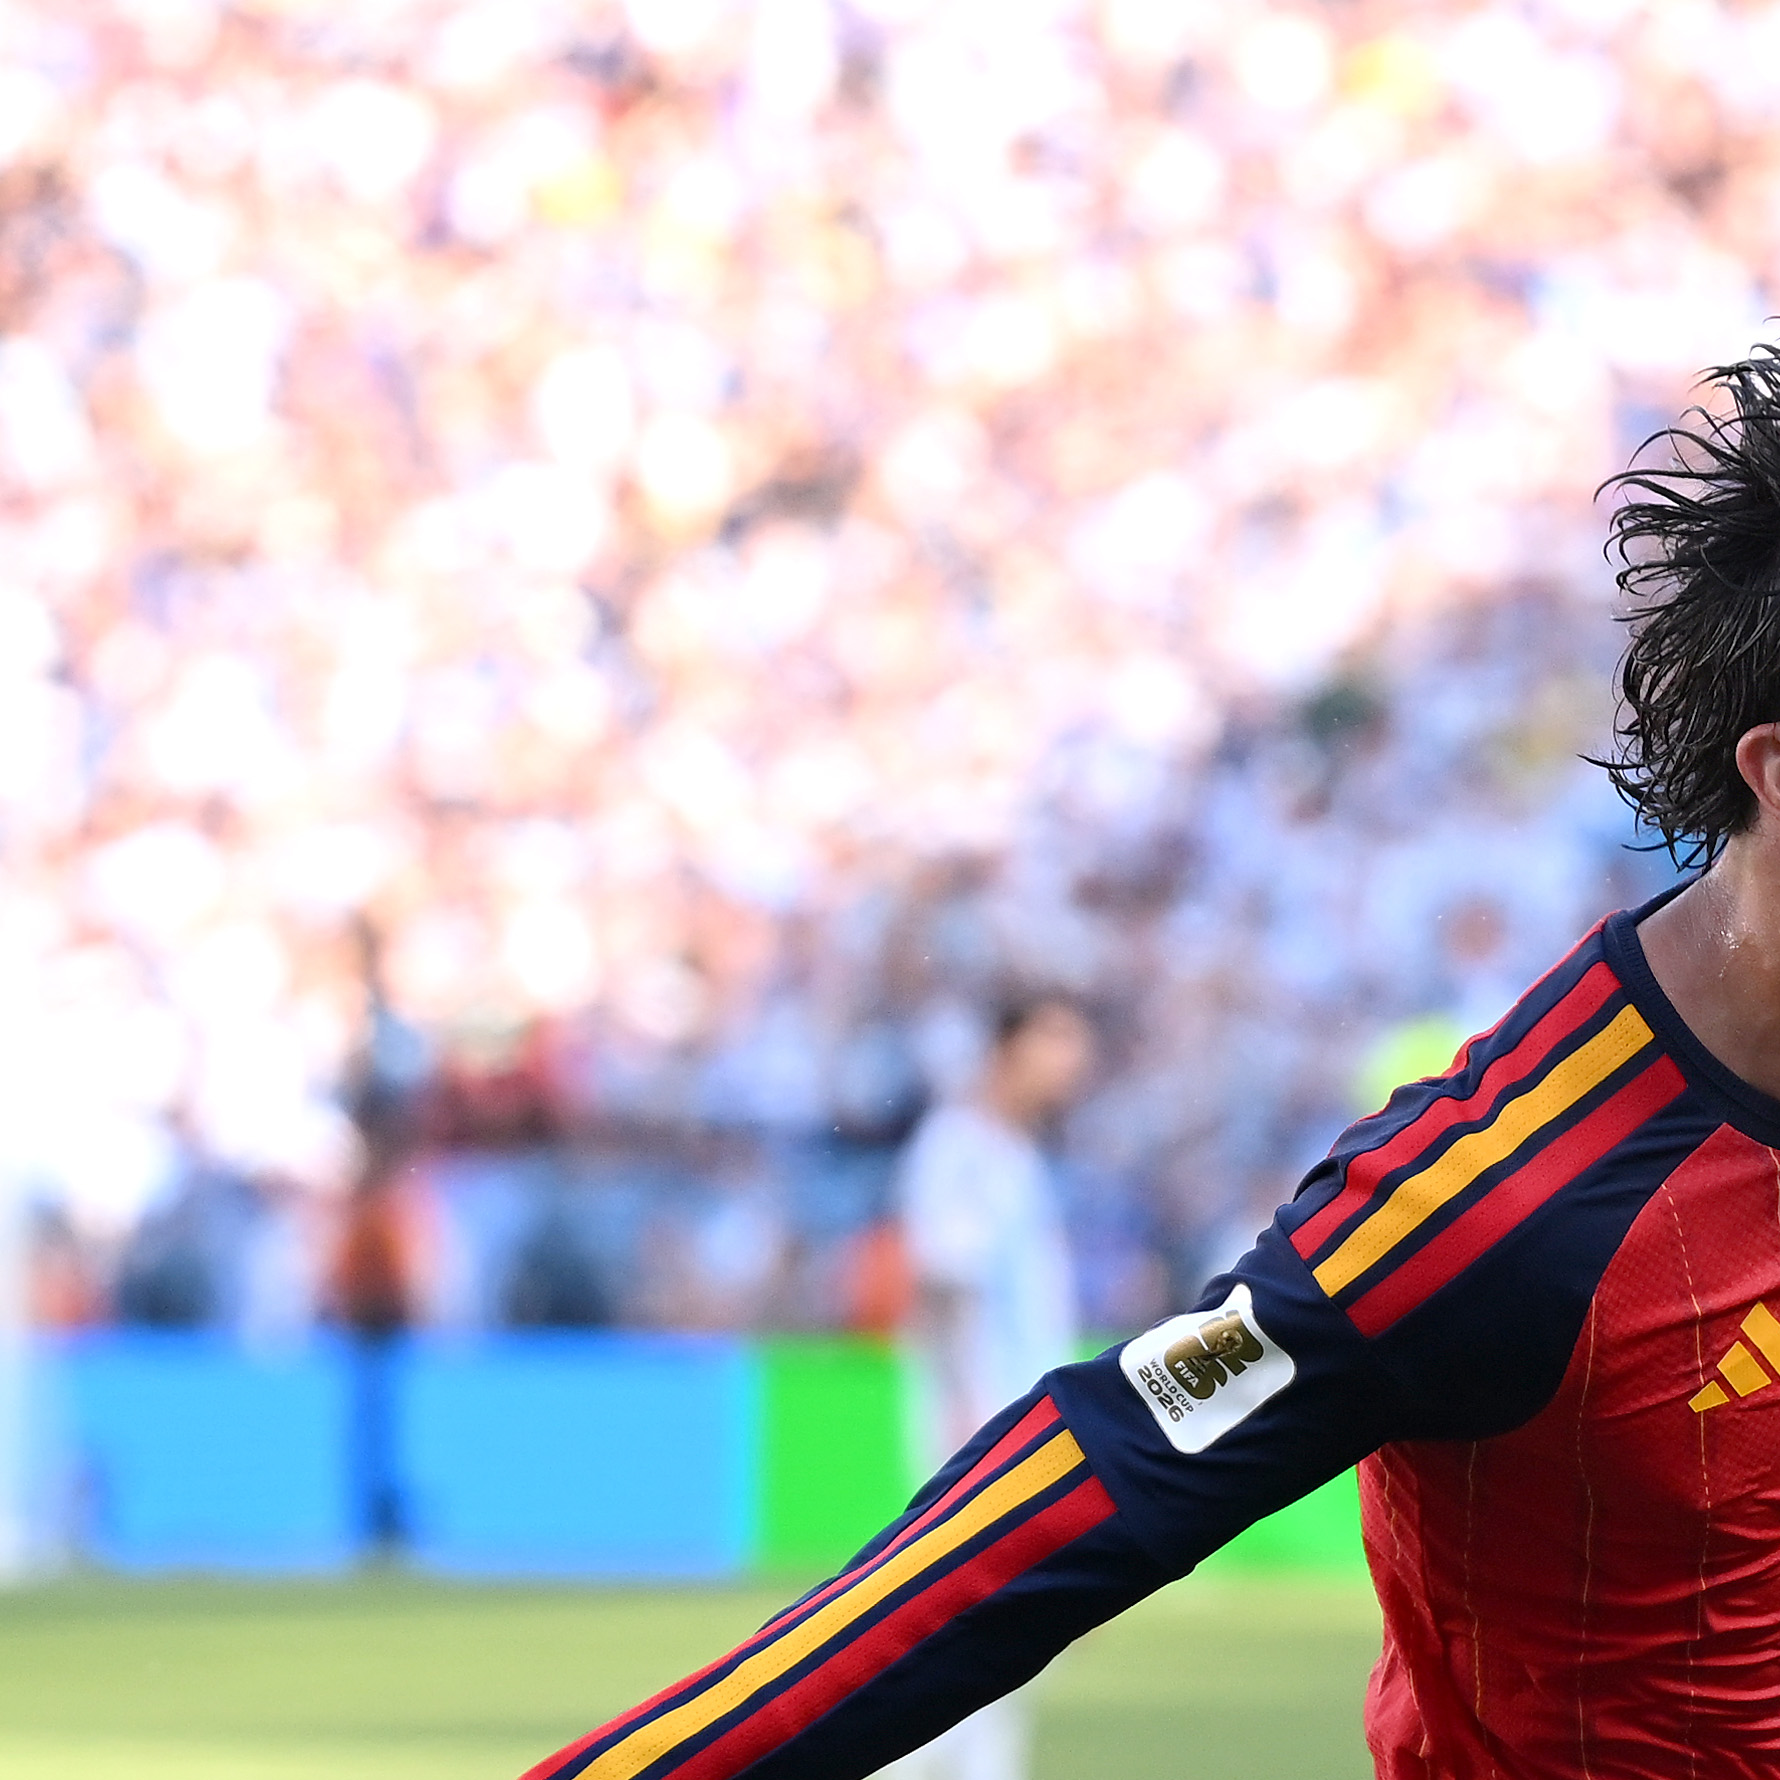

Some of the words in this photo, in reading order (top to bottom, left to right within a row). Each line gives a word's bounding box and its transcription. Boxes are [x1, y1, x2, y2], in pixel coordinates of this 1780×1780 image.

[1137, 1365, 1185, 1422] 2026
[1149, 1358, 1178, 1395] WORLD
[1176, 1393, 1195, 1413] CUP
[1174, 1360, 1199, 1388] FIFA
